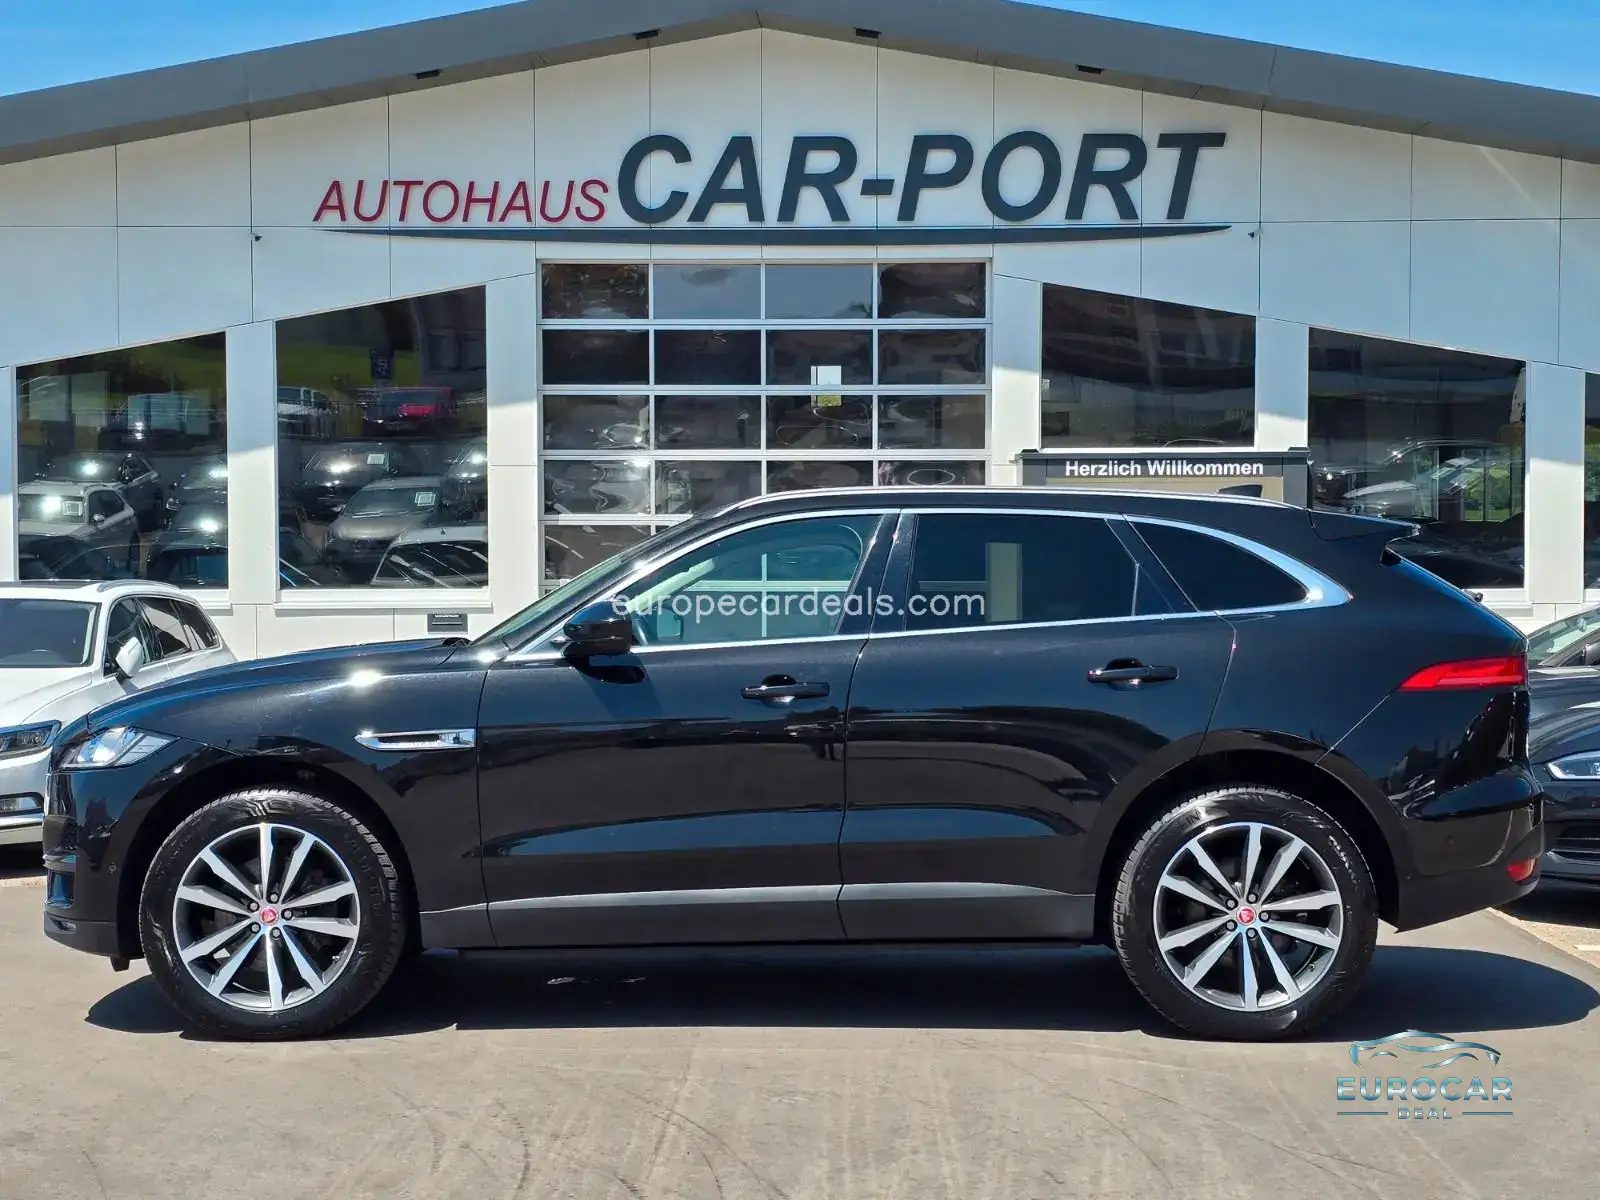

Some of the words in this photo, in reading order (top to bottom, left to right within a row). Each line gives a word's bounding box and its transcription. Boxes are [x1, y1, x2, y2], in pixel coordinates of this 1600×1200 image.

[312, 179, 609, 223] AUTOHAUS
[617, 130, 1227, 225] CAR-PORT
[1065, 460, 1142, 476] Herzlich
[1147, 460, 1264, 476] Willkommen
